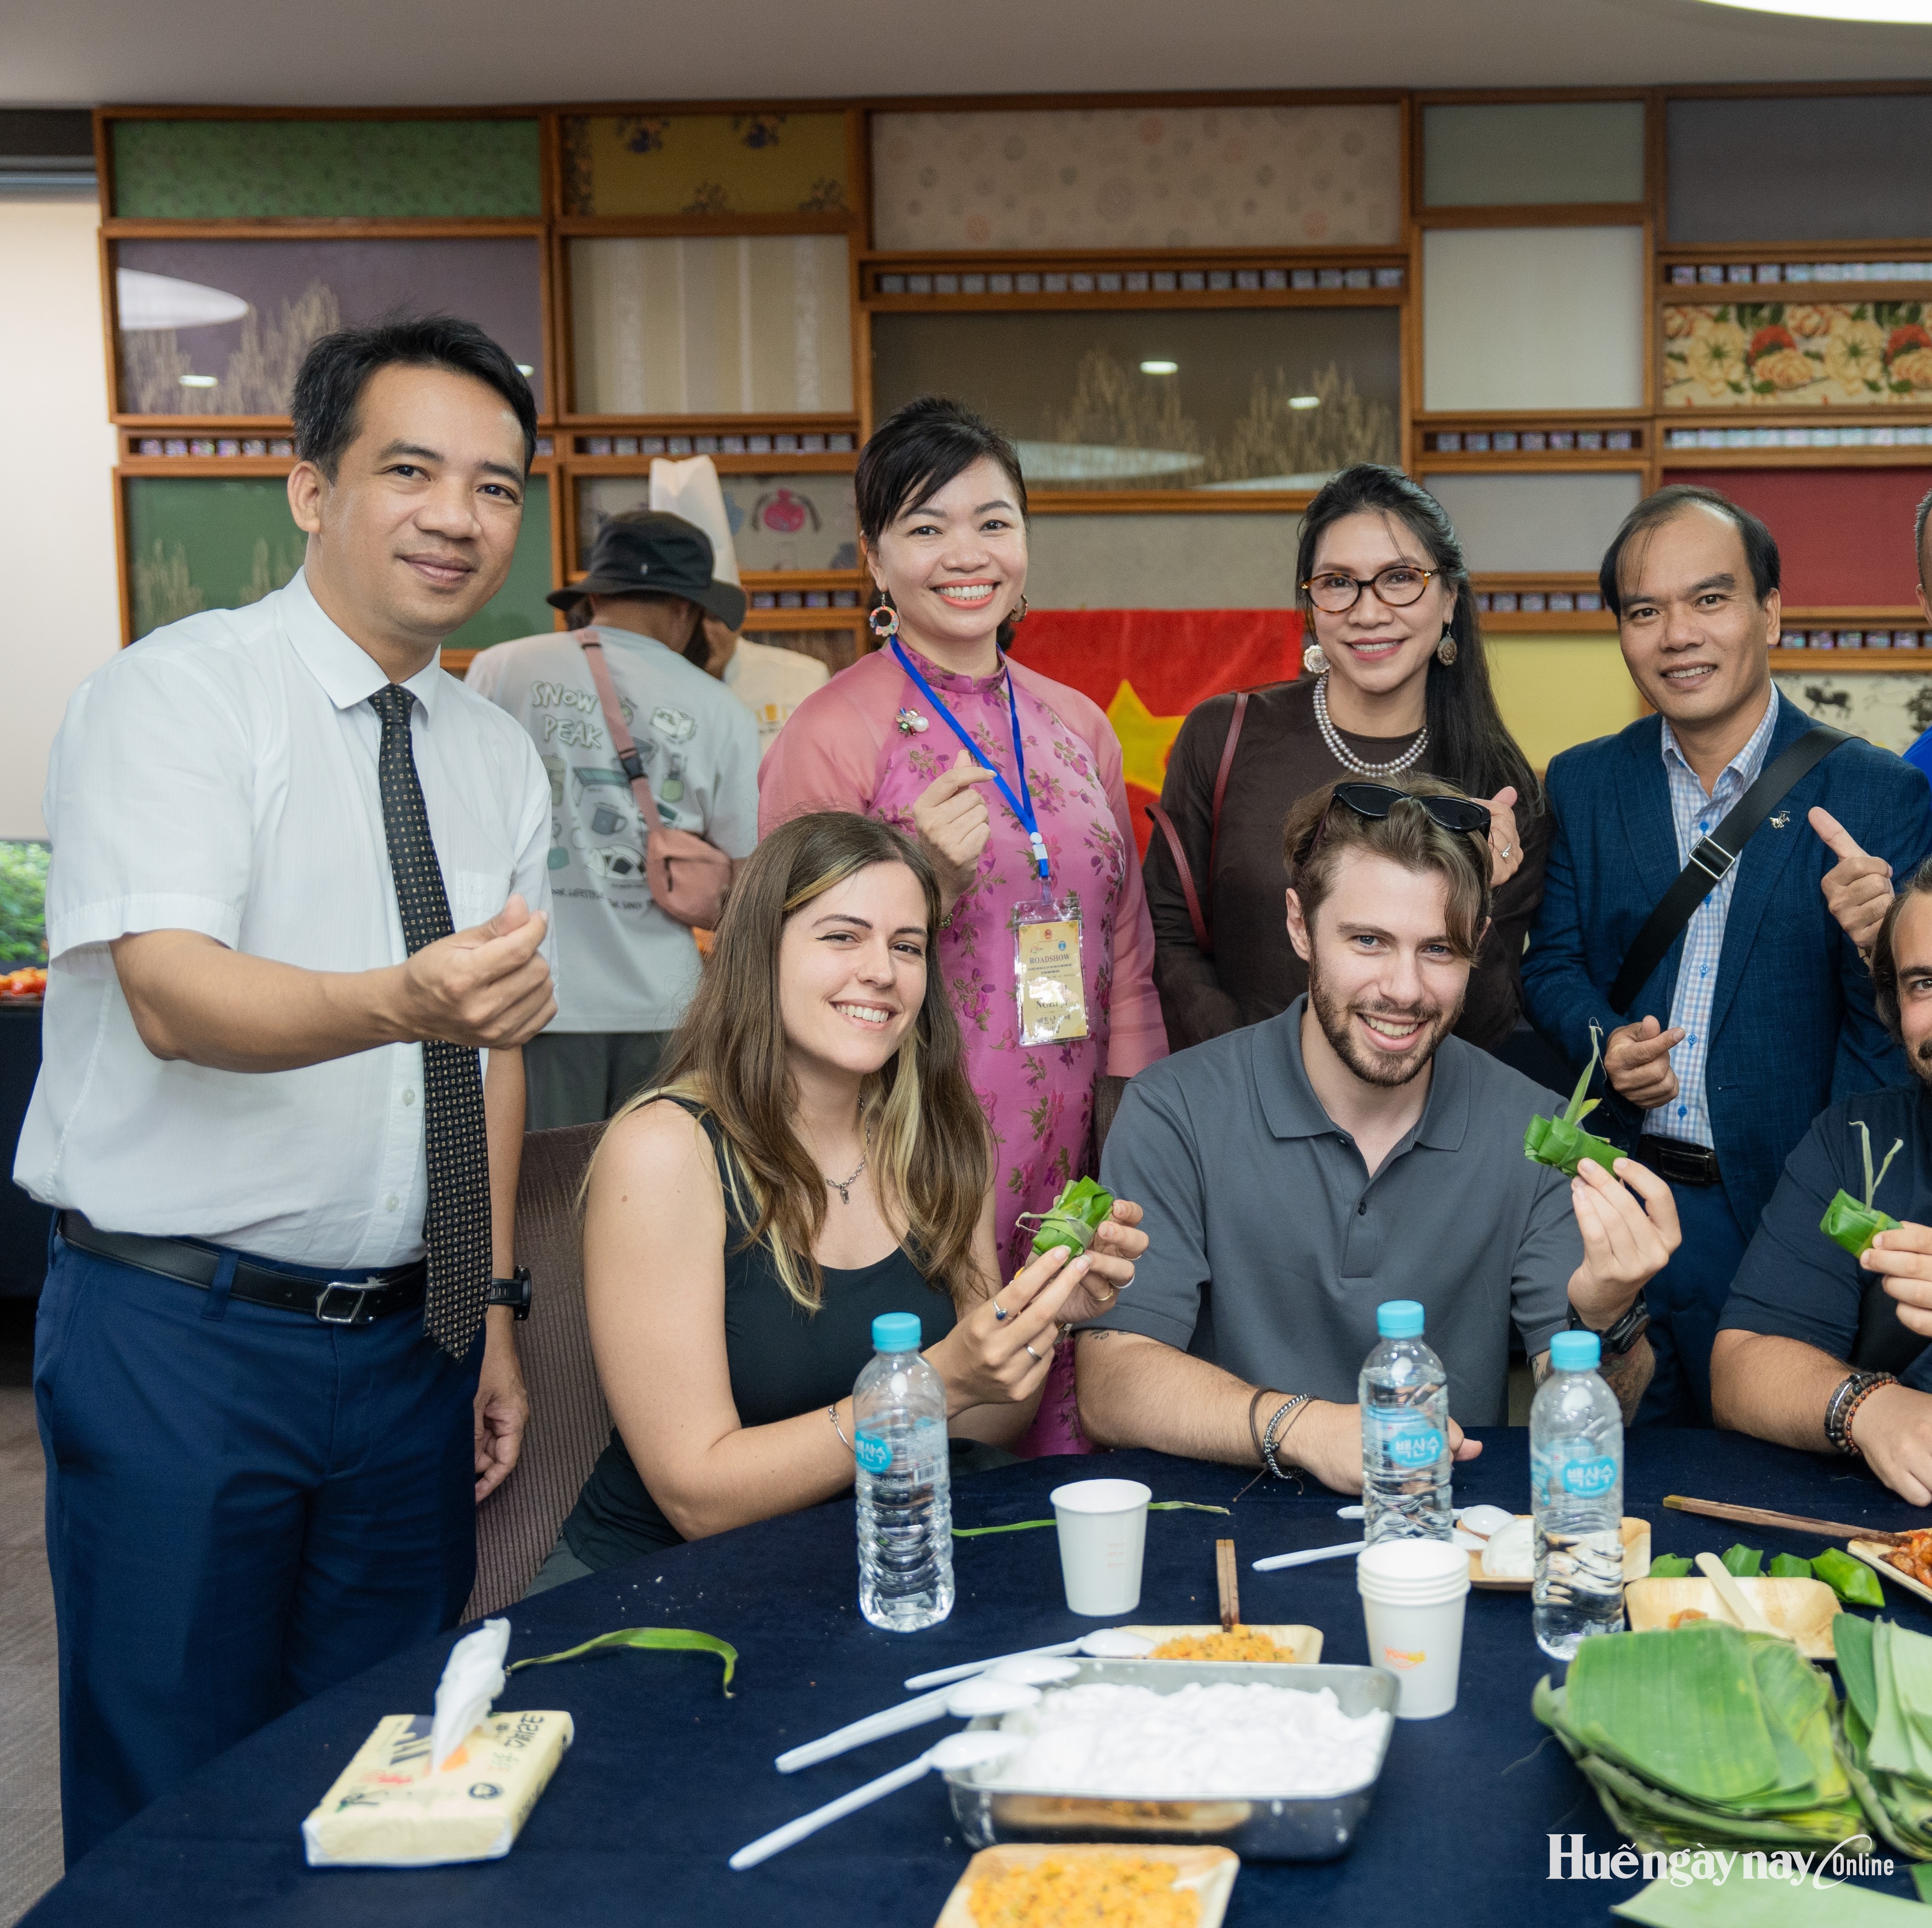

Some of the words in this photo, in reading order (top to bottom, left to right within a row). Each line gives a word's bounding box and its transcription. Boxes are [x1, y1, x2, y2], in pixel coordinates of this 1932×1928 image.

[533, 681, 599, 714] SNOW
[542, 714, 603, 749] PEAK
[1030, 953, 1070, 964] ROADSHOW
[1395, 1436, 1440, 1459] 백산수
[1567, 1464, 1614, 1487] 백산수
